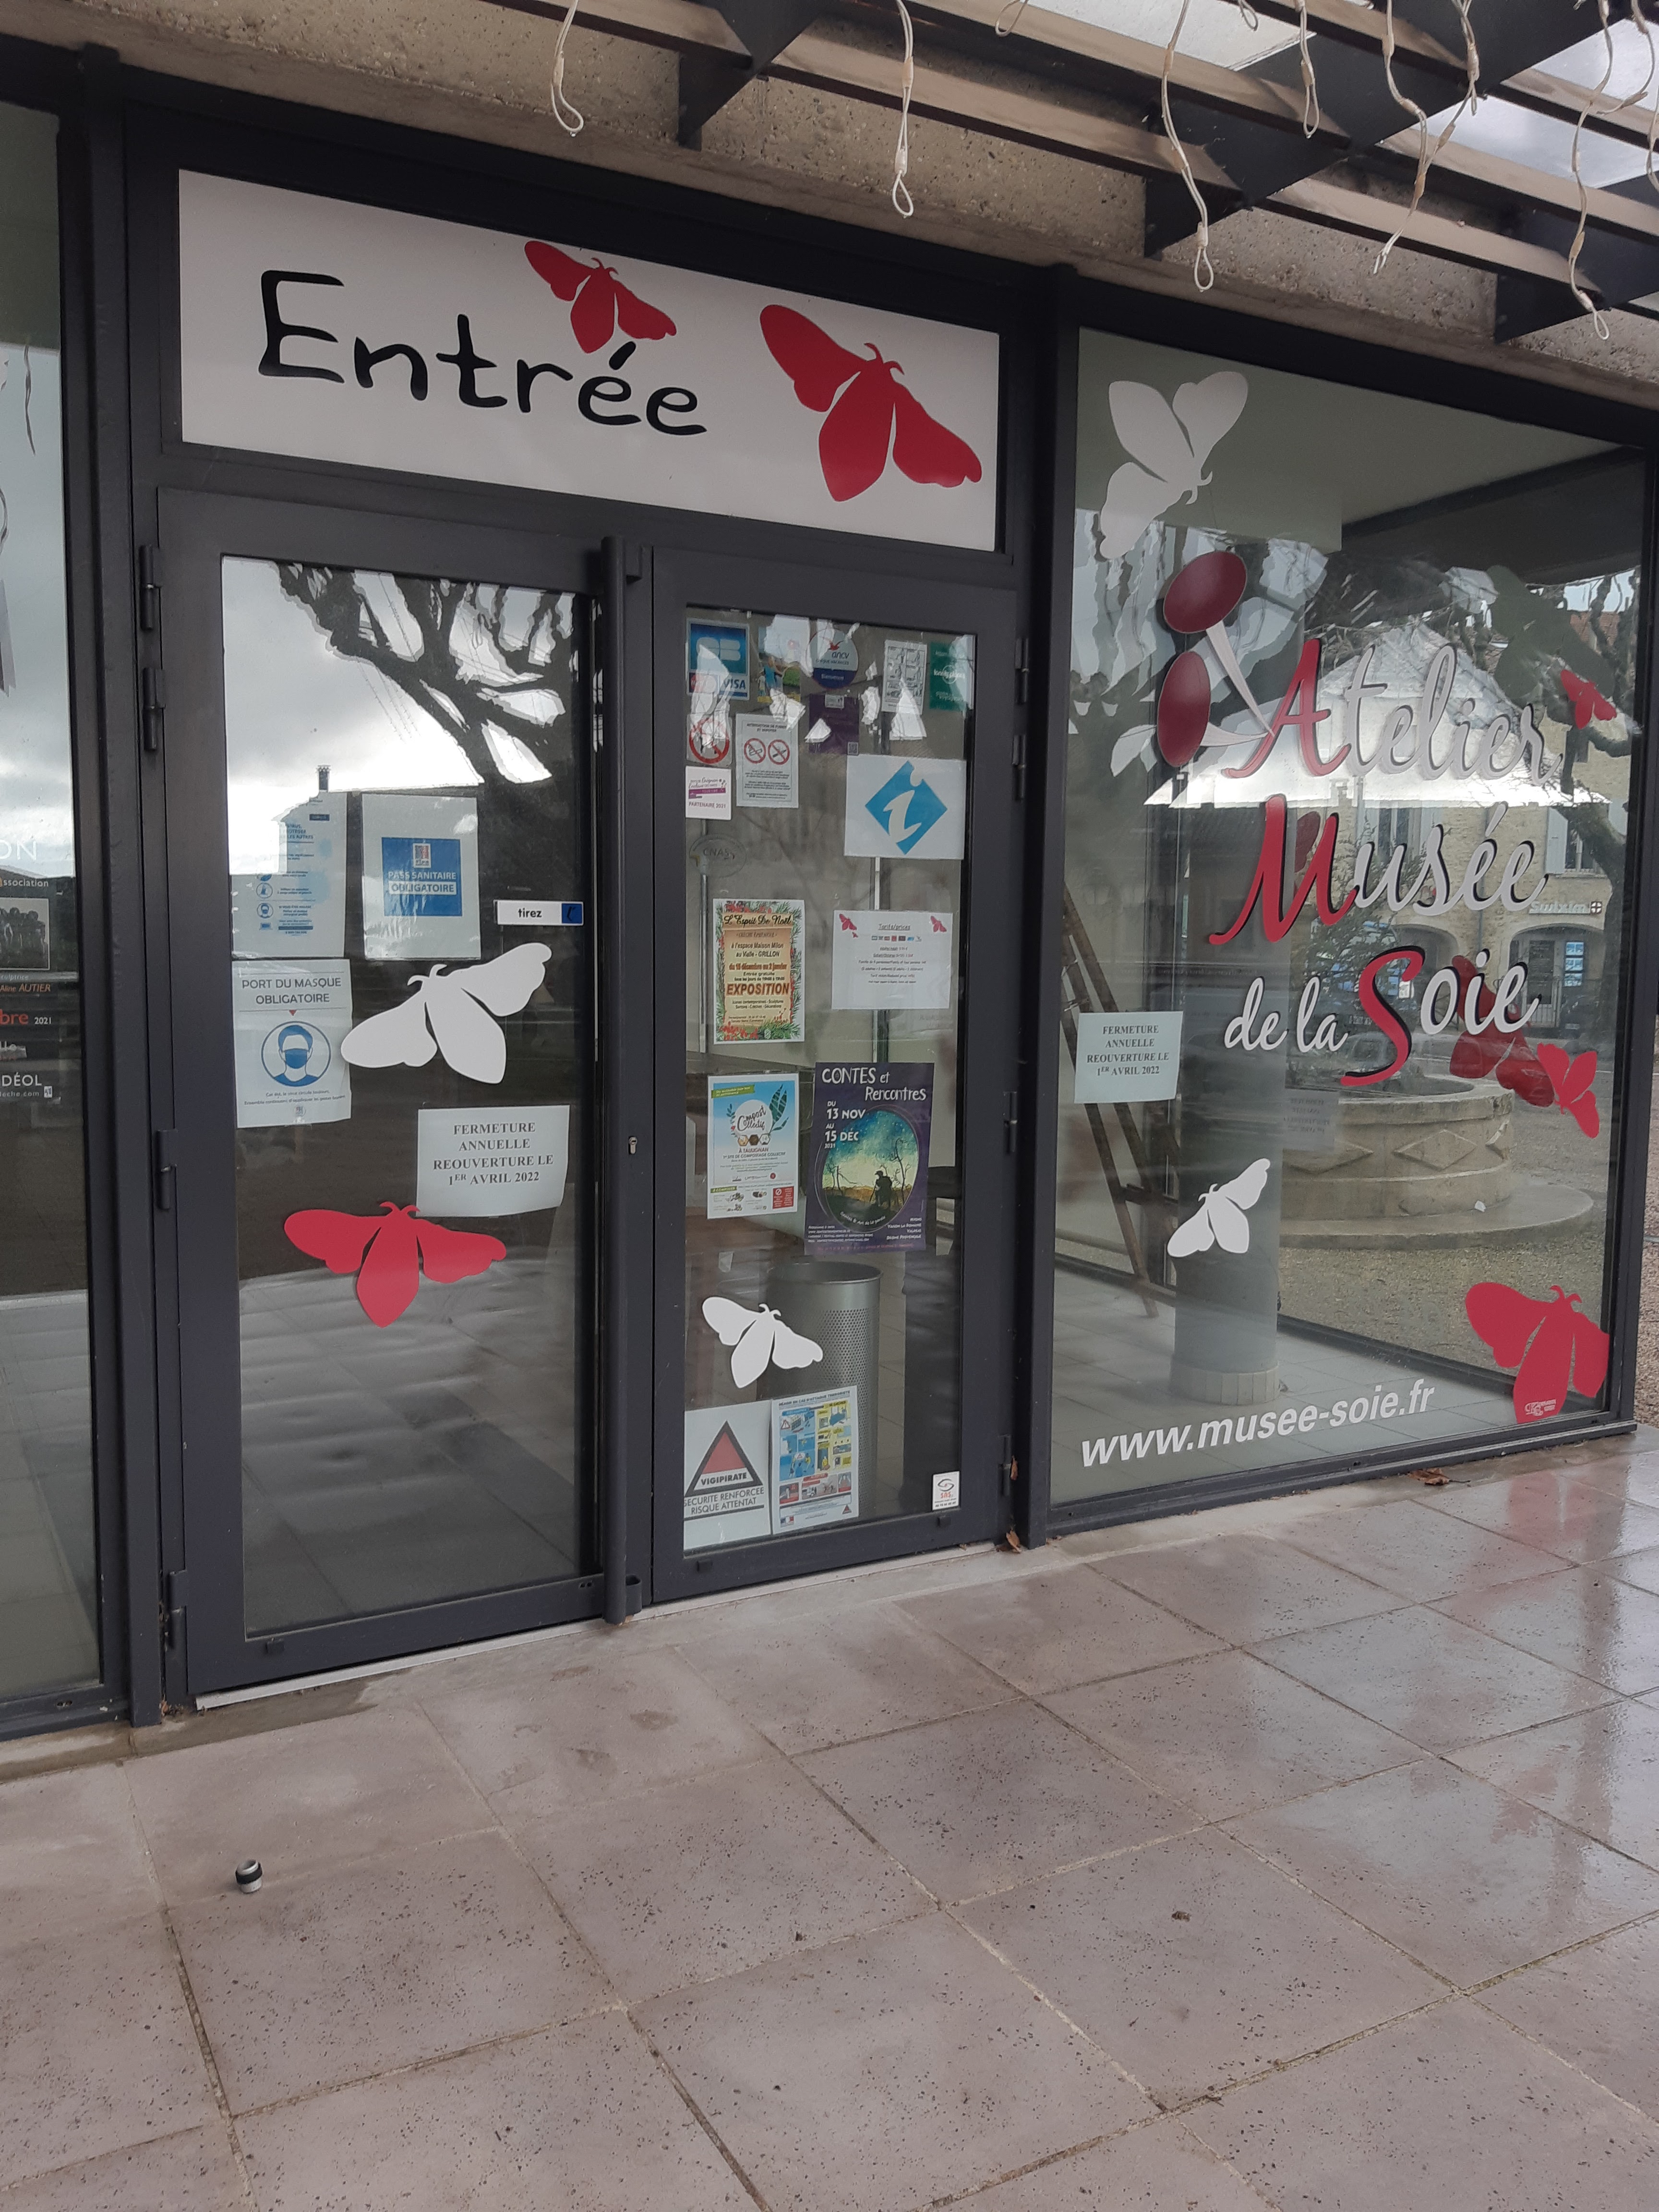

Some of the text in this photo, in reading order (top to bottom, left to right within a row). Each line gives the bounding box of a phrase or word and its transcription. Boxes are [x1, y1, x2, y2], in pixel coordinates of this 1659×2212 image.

[258, 269, 707, 436] Entrée
[723, 678, 746, 690] VISA
[1221, 637, 1563, 785] Atelier
[388, 871, 457, 879] PASS SANITAIRE
[1208, 793, 1549, 945] Musée
[391, 883, 454, 892] OBLIGATOIRE
[518, 907, 542, 918] tirez
[724, 914, 757, 928] L'Esprit
[19, 983, 51, 992] AUTIER
[242, 977, 341, 988] PORT DU MASQUE
[727, 982, 790, 995] EXPOSITION
[256, 993, 330, 1004] OBLIGATOIRE
[34, 1016, 52, 1024] 2021
[1224, 945, 1541, 1086] de la Soie
[1103, 1025, 1159, 1034] FERMETURE
[1106, 1038, 1154, 1048] ANNUELLE
[1087, 1052, 1169, 1063] REOUVERTURE LE
[822, 1067, 890, 1084] CONTES et
[1111, 1066, 1140, 1076] AVRIL
[1142, 1066, 1159, 1074] 2022
[865, 1086, 927, 1101] Rencontres
[827, 1108, 866, 1119] 13 NOV
[453, 1122, 536, 1135] FERMETURE
[825, 1128, 859, 1142] 15 DÉC
[459, 1138, 530, 1151] ANNUELLE
[433, 1154, 553, 1170] REOUVERTURE LE
[470, 1172, 512, 1185] AVRIL
[515, 1171, 540, 1182] 2022
[1082, 1378, 1435, 1467] www.musee-soie.fr
[701, 1472, 747, 1485] VIGIPIRATE
[684, 1487, 764, 1507] SECURITE RENFORCEE
[691, 1497, 757, 1515] RISQUE ATTENTAT
